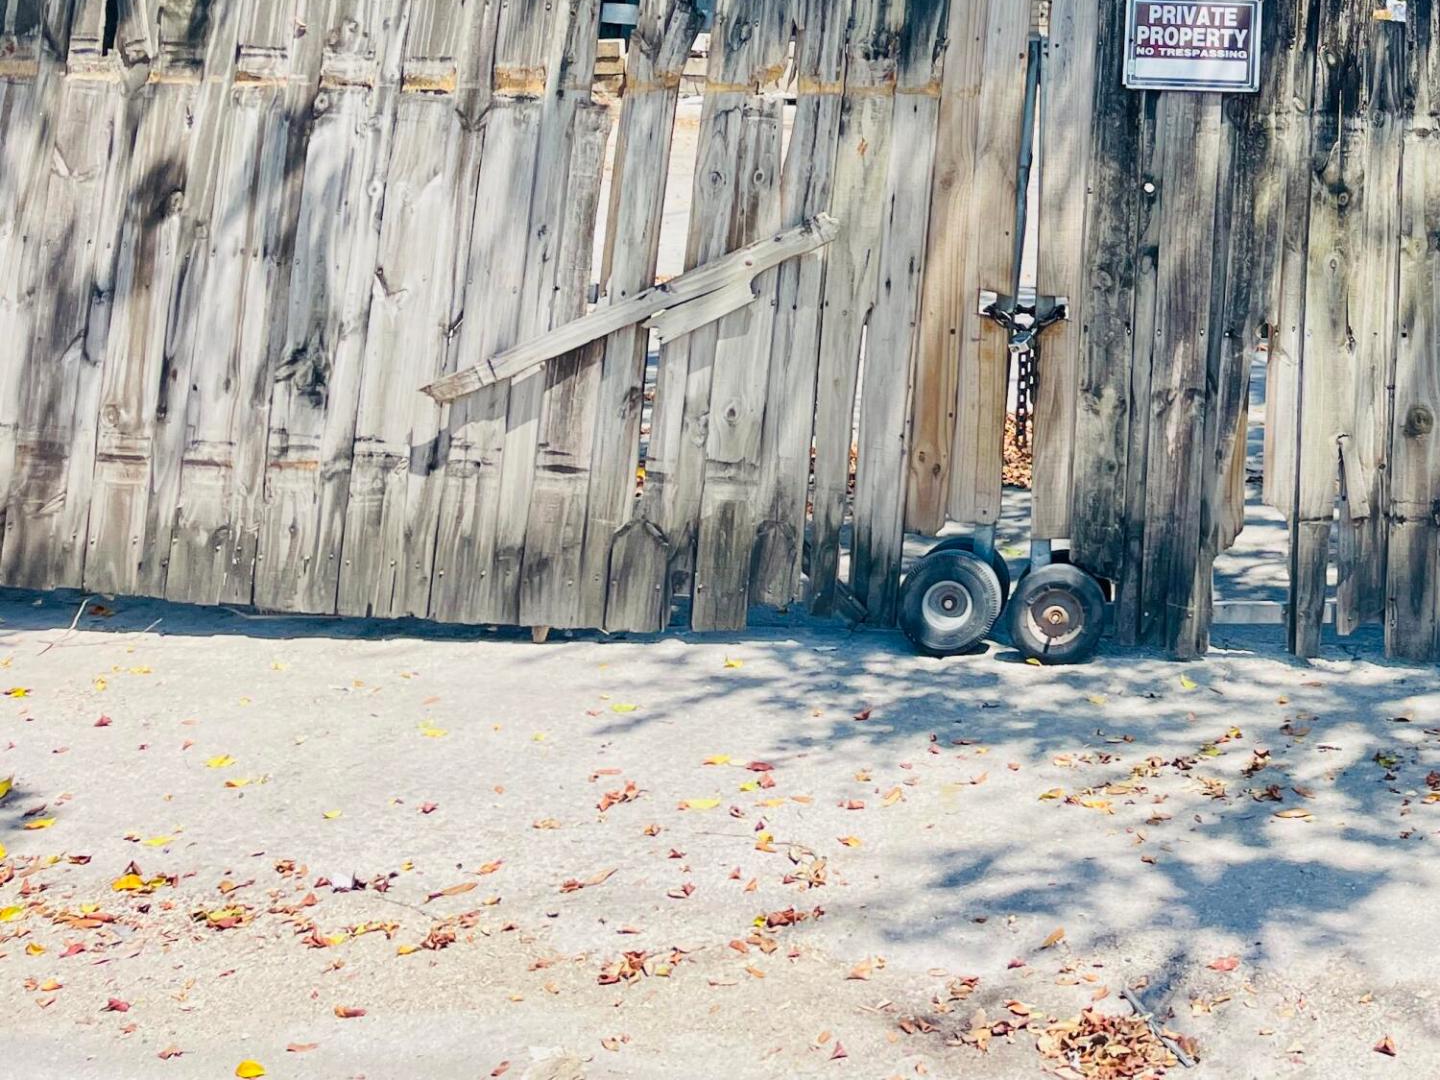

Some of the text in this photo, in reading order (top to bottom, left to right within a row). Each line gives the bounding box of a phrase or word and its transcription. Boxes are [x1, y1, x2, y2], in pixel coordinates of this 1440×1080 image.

[1149, 5, 1237, 26] PRIVATE
[1136, 26, 1248, 48] PROPERTY
[1136, 47, 1247, 59] NO TRESPASSING
